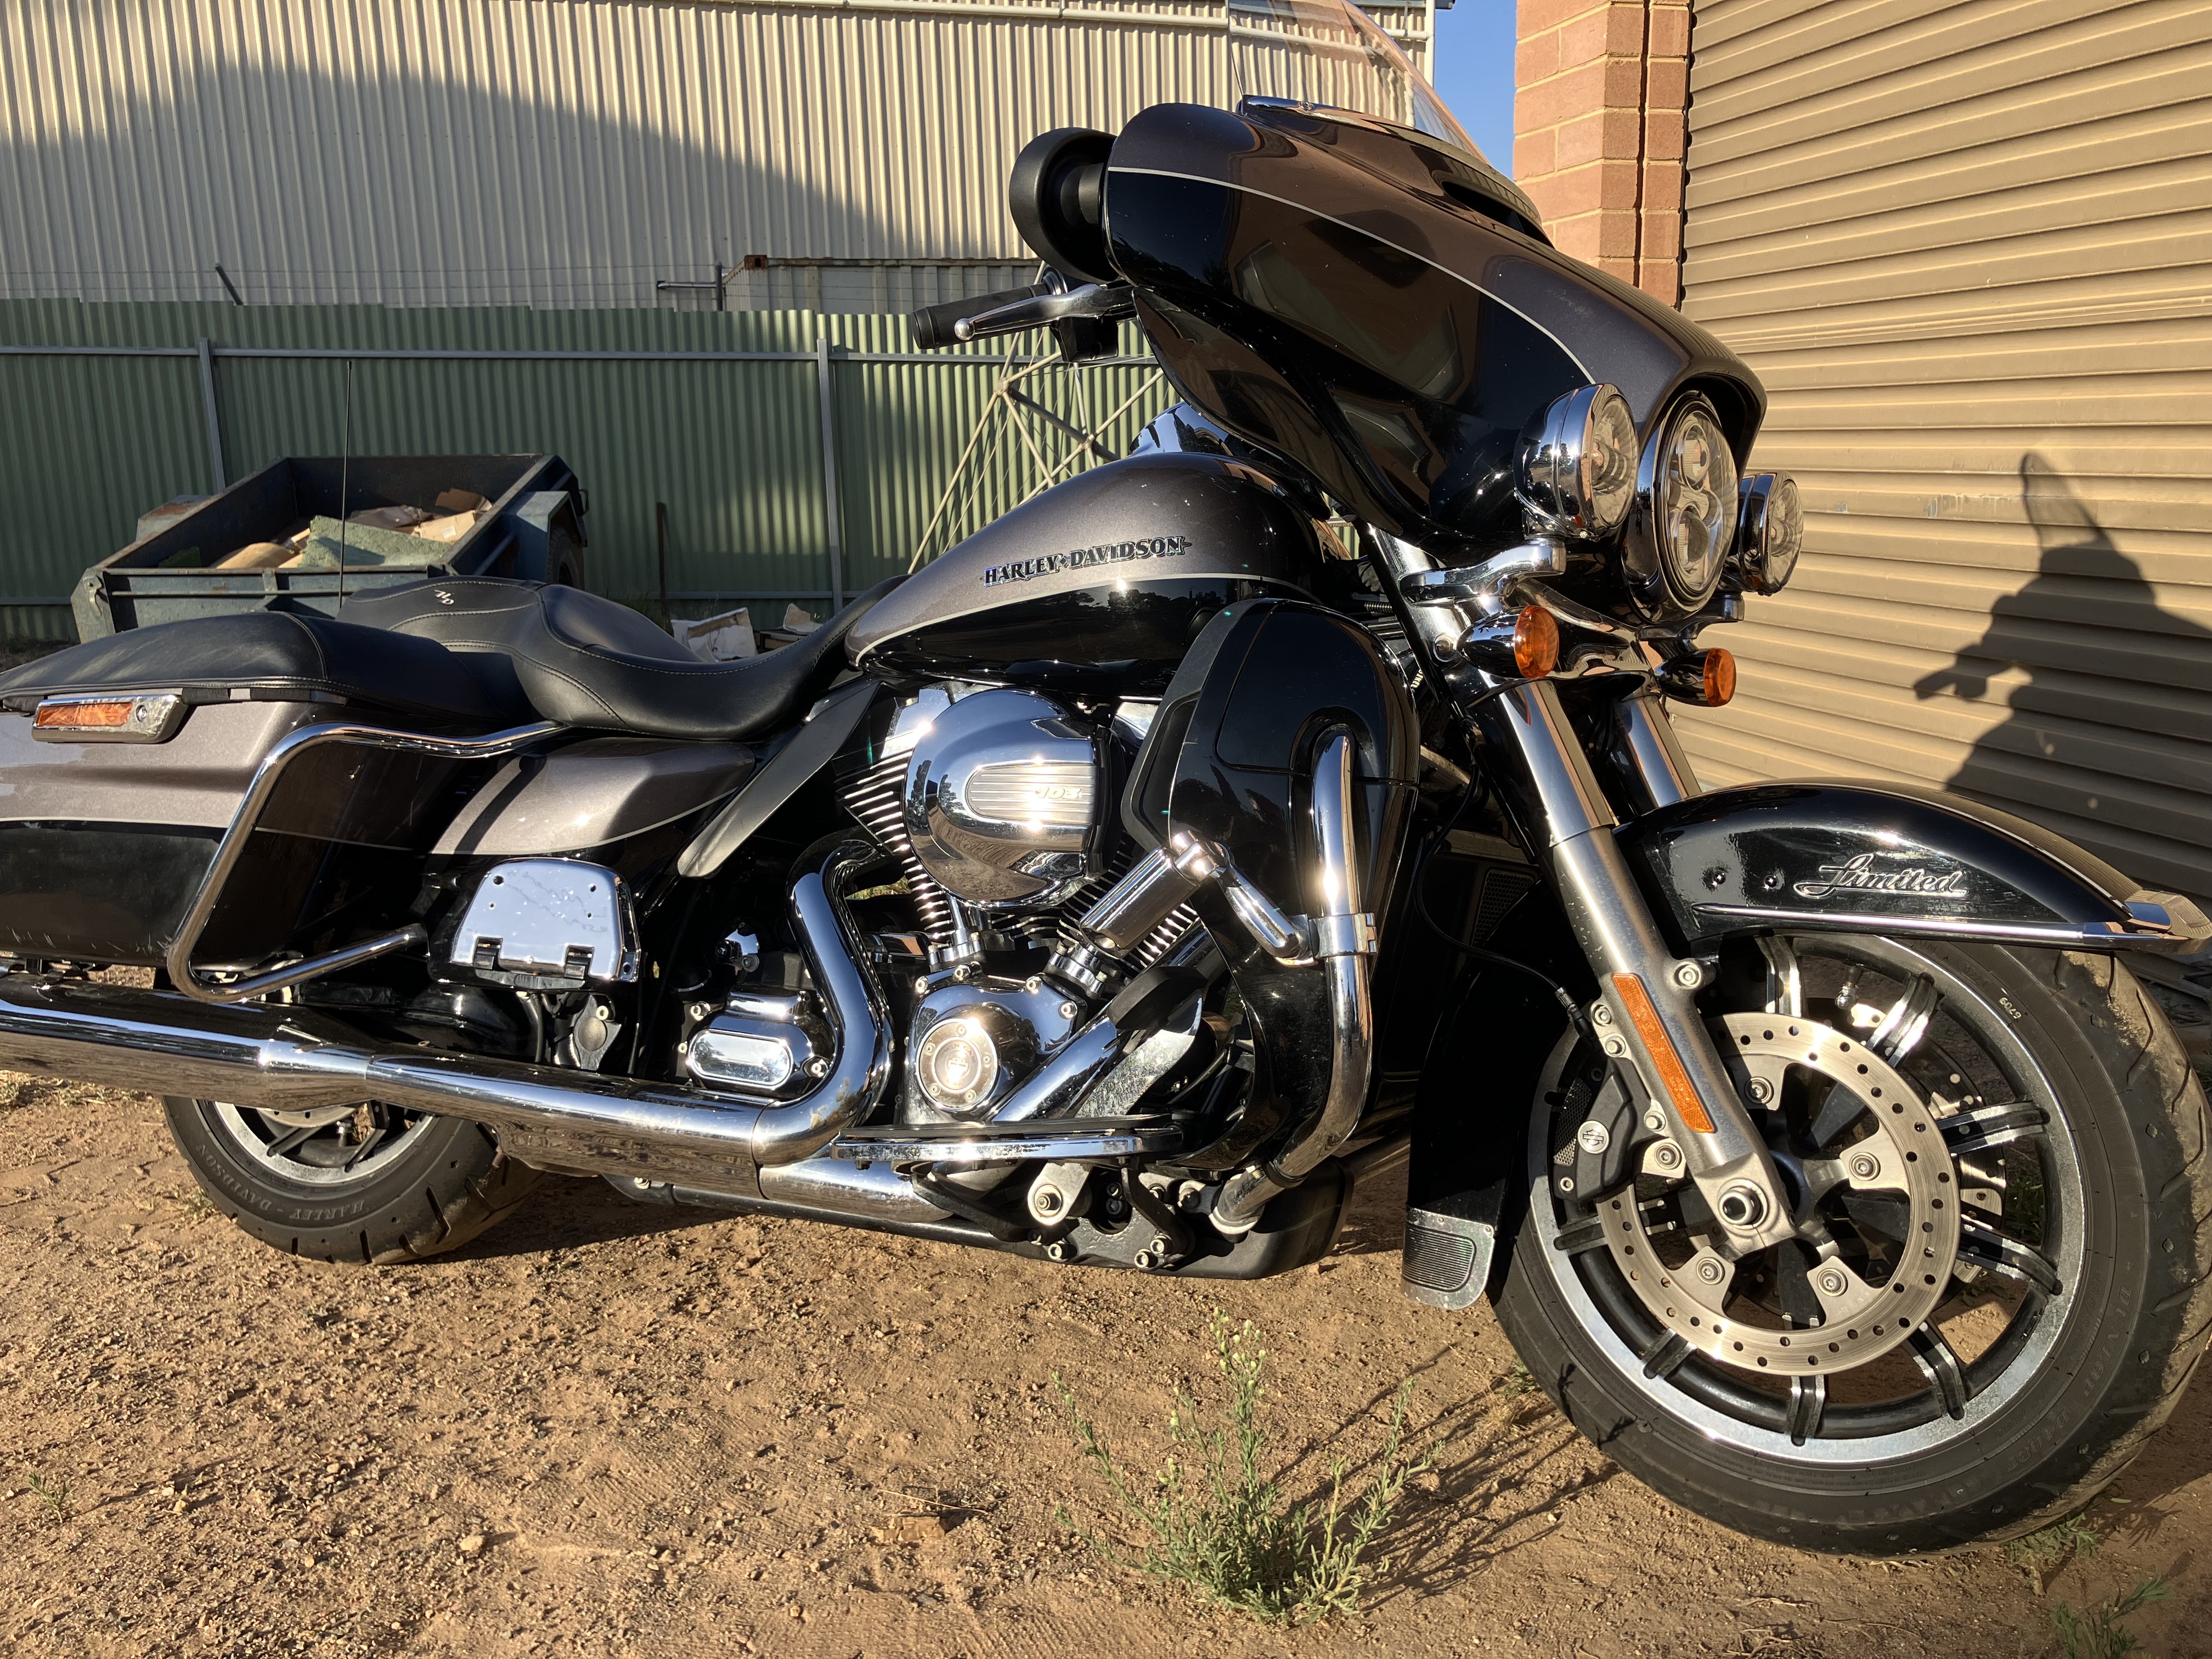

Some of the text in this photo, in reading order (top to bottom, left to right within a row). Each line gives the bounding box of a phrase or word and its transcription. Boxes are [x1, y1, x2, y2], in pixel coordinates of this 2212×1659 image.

[1036, 787, 1082, 800] 103
[1793, 853, 1970, 899] Limited
[2083, 1283, 2132, 1398] DUNLOP
[2007, 1406, 2072, 1473] D408F
